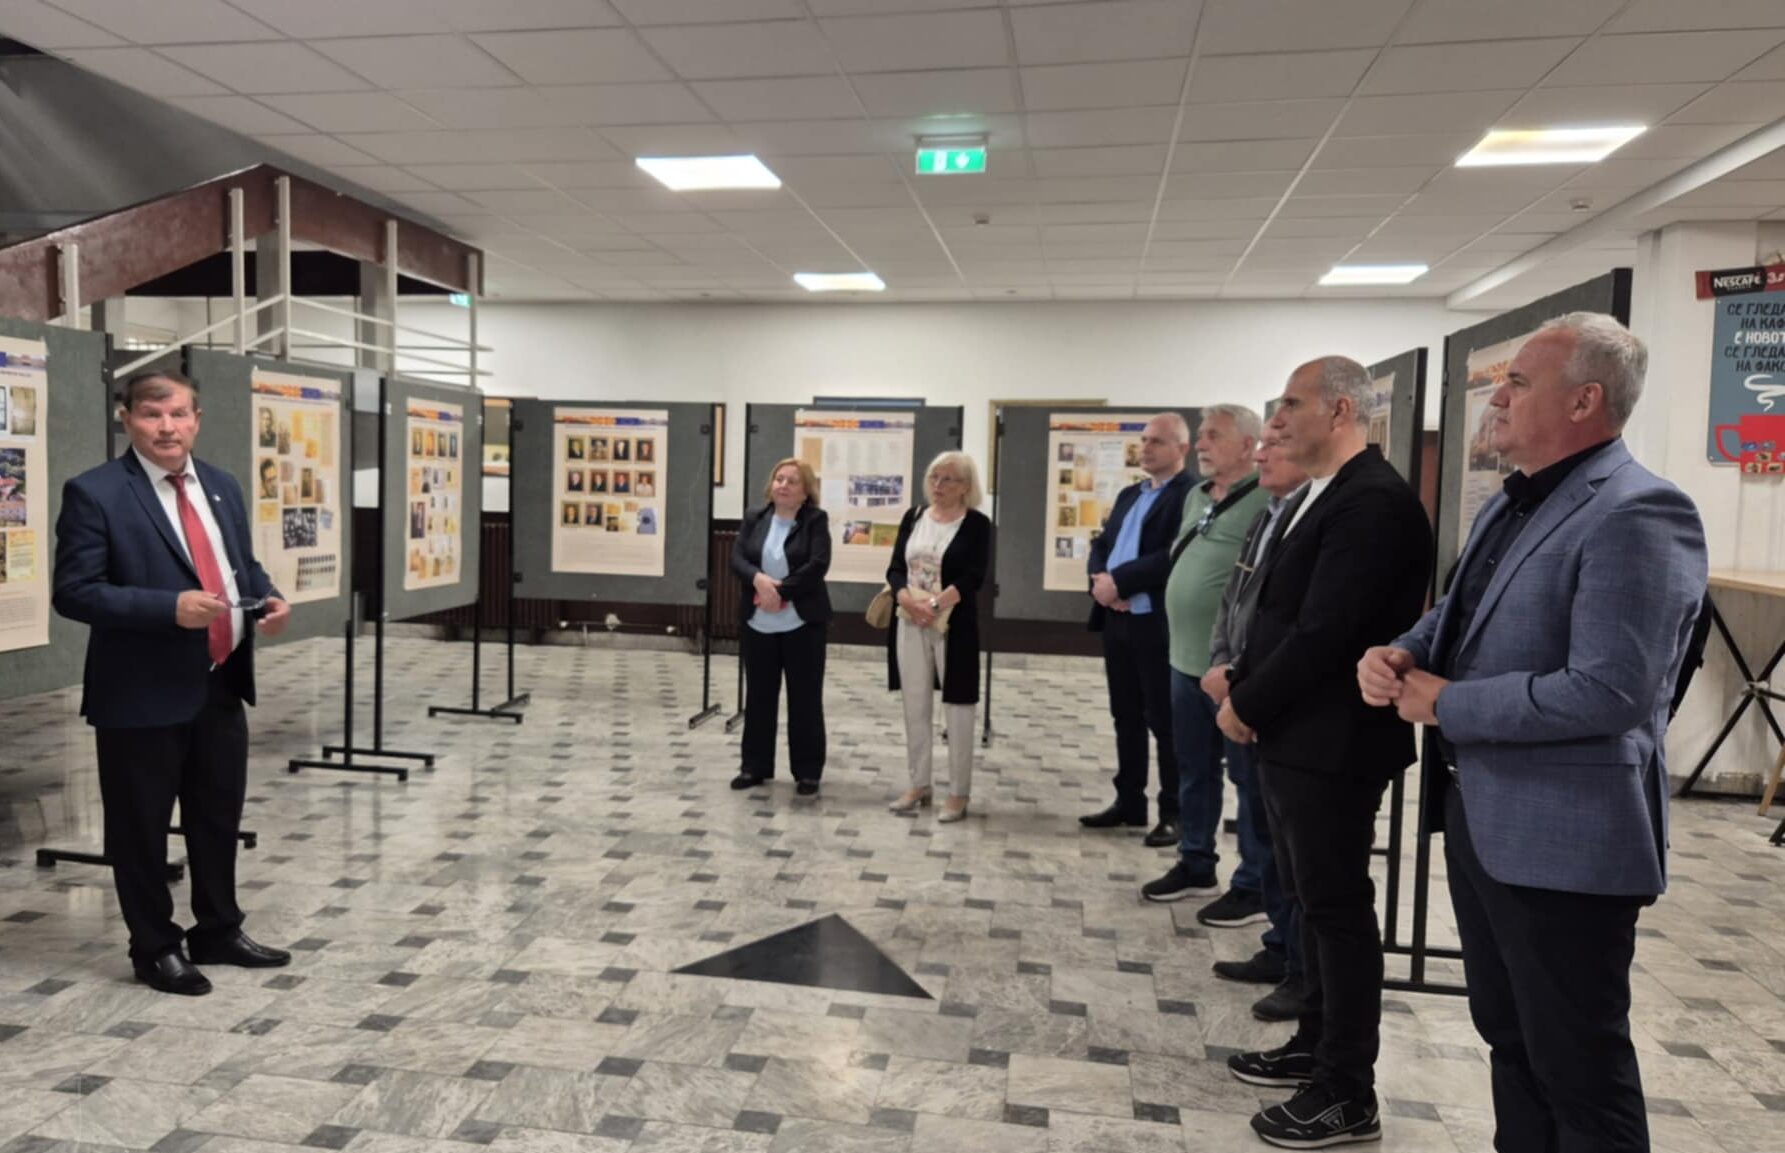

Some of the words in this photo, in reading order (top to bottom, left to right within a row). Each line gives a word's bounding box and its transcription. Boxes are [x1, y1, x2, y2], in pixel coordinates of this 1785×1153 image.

[1727, 303, 1742, 316] СЕ
[1741, 318, 1756, 329] НА
[1724, 346, 1740, 359] СЕ
[1736, 361, 1751, 372] НА
